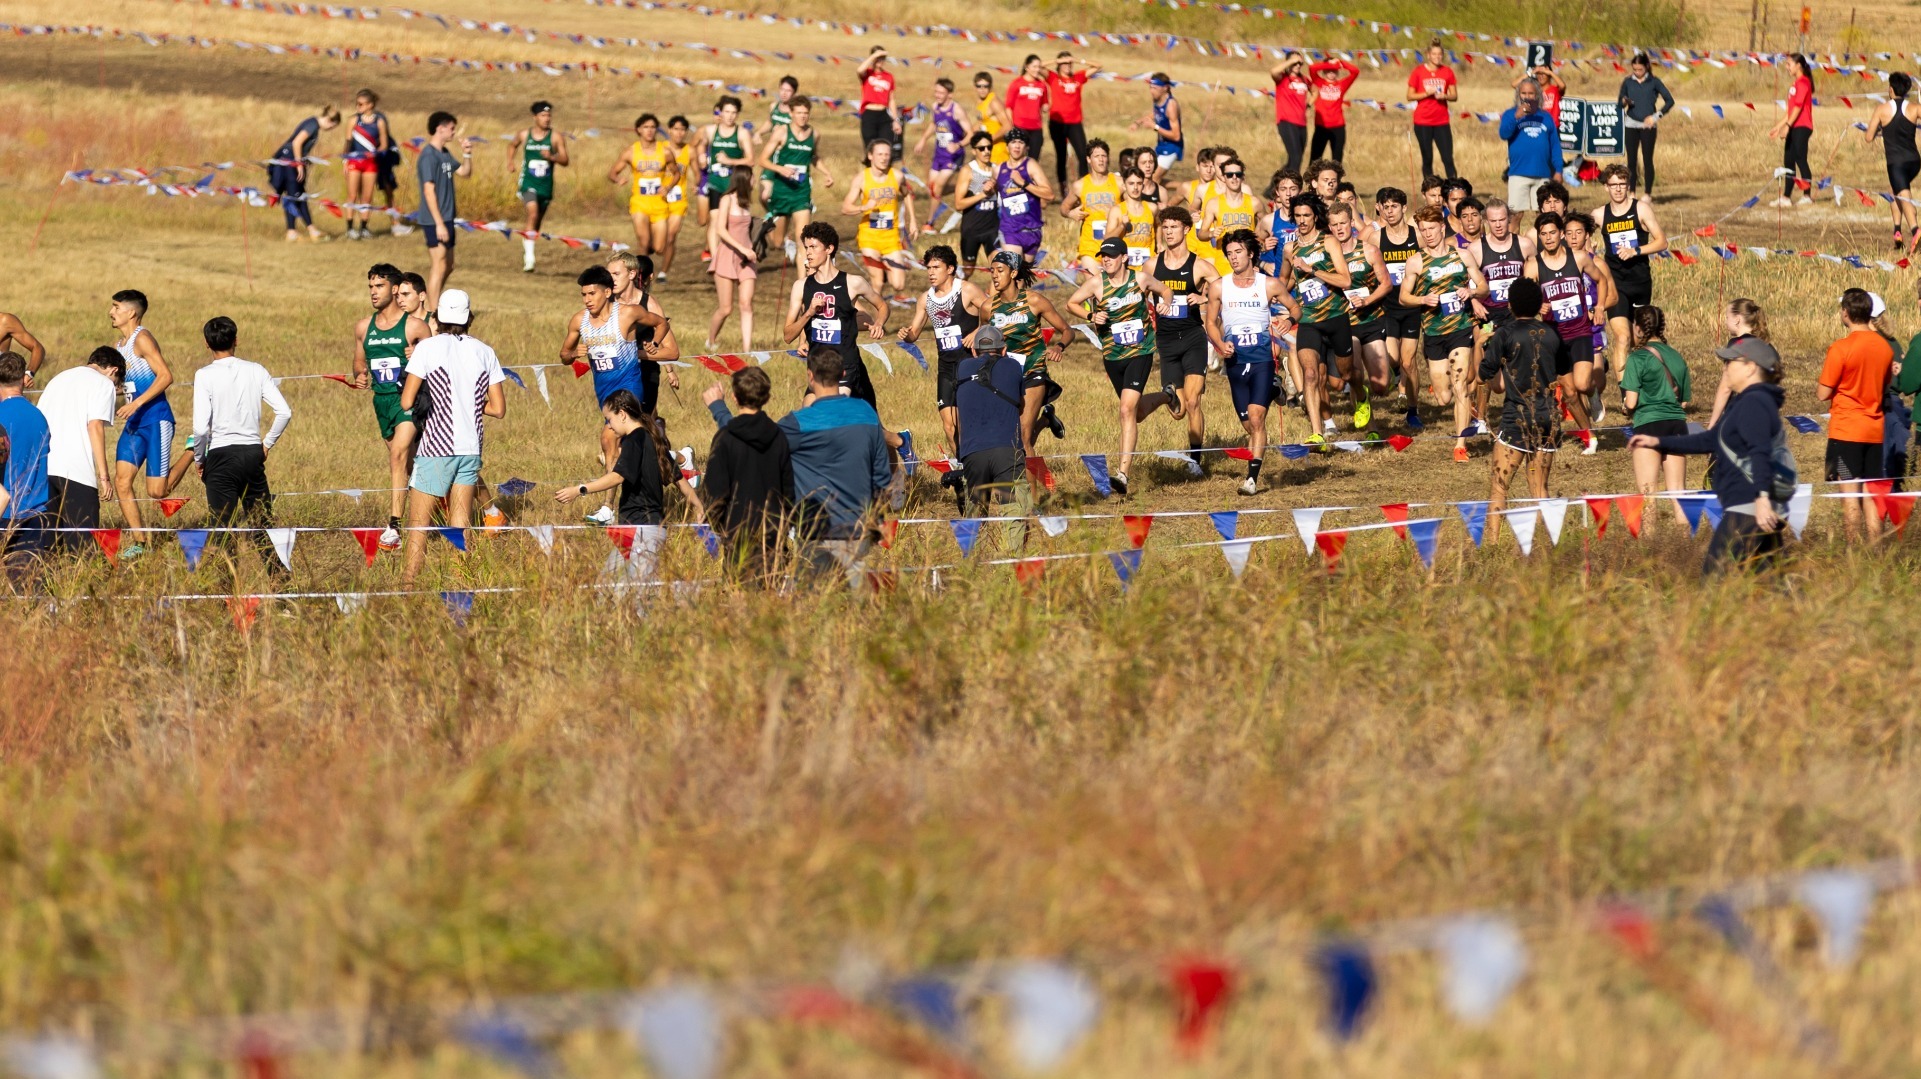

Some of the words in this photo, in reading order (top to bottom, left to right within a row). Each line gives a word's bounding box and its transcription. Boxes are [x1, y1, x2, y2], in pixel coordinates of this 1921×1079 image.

[1534, 45, 1546, 66] 2
[1559, 111, 1581, 123] OOP
[1591, 104, 1617, 116] W6K
[1590, 115, 1619, 127] LOOP
[1606, 220, 1635, 233] CAMERON
[1487, 266, 1503, 280] WEST
[1503, 264, 1521, 277] TEXAS
[1305, 286, 1325, 302] 195
[1495, 289, 1510, 301] 24
[1544, 283, 1560, 299] WEST
[1560, 279, 1579, 294] TEXAS
[1105, 291, 1143, 312] Dallas
[990, 311, 1029, 328] Dallas
[1557, 307, 1579, 321] 243
[816, 329, 835, 342] 117
[1119, 329, 1139, 345] 197
[1237, 333, 1258, 347] 218
[940, 336, 959, 350] 180
[594, 358, 615, 371] 158
[378, 368, 394, 382] 70
